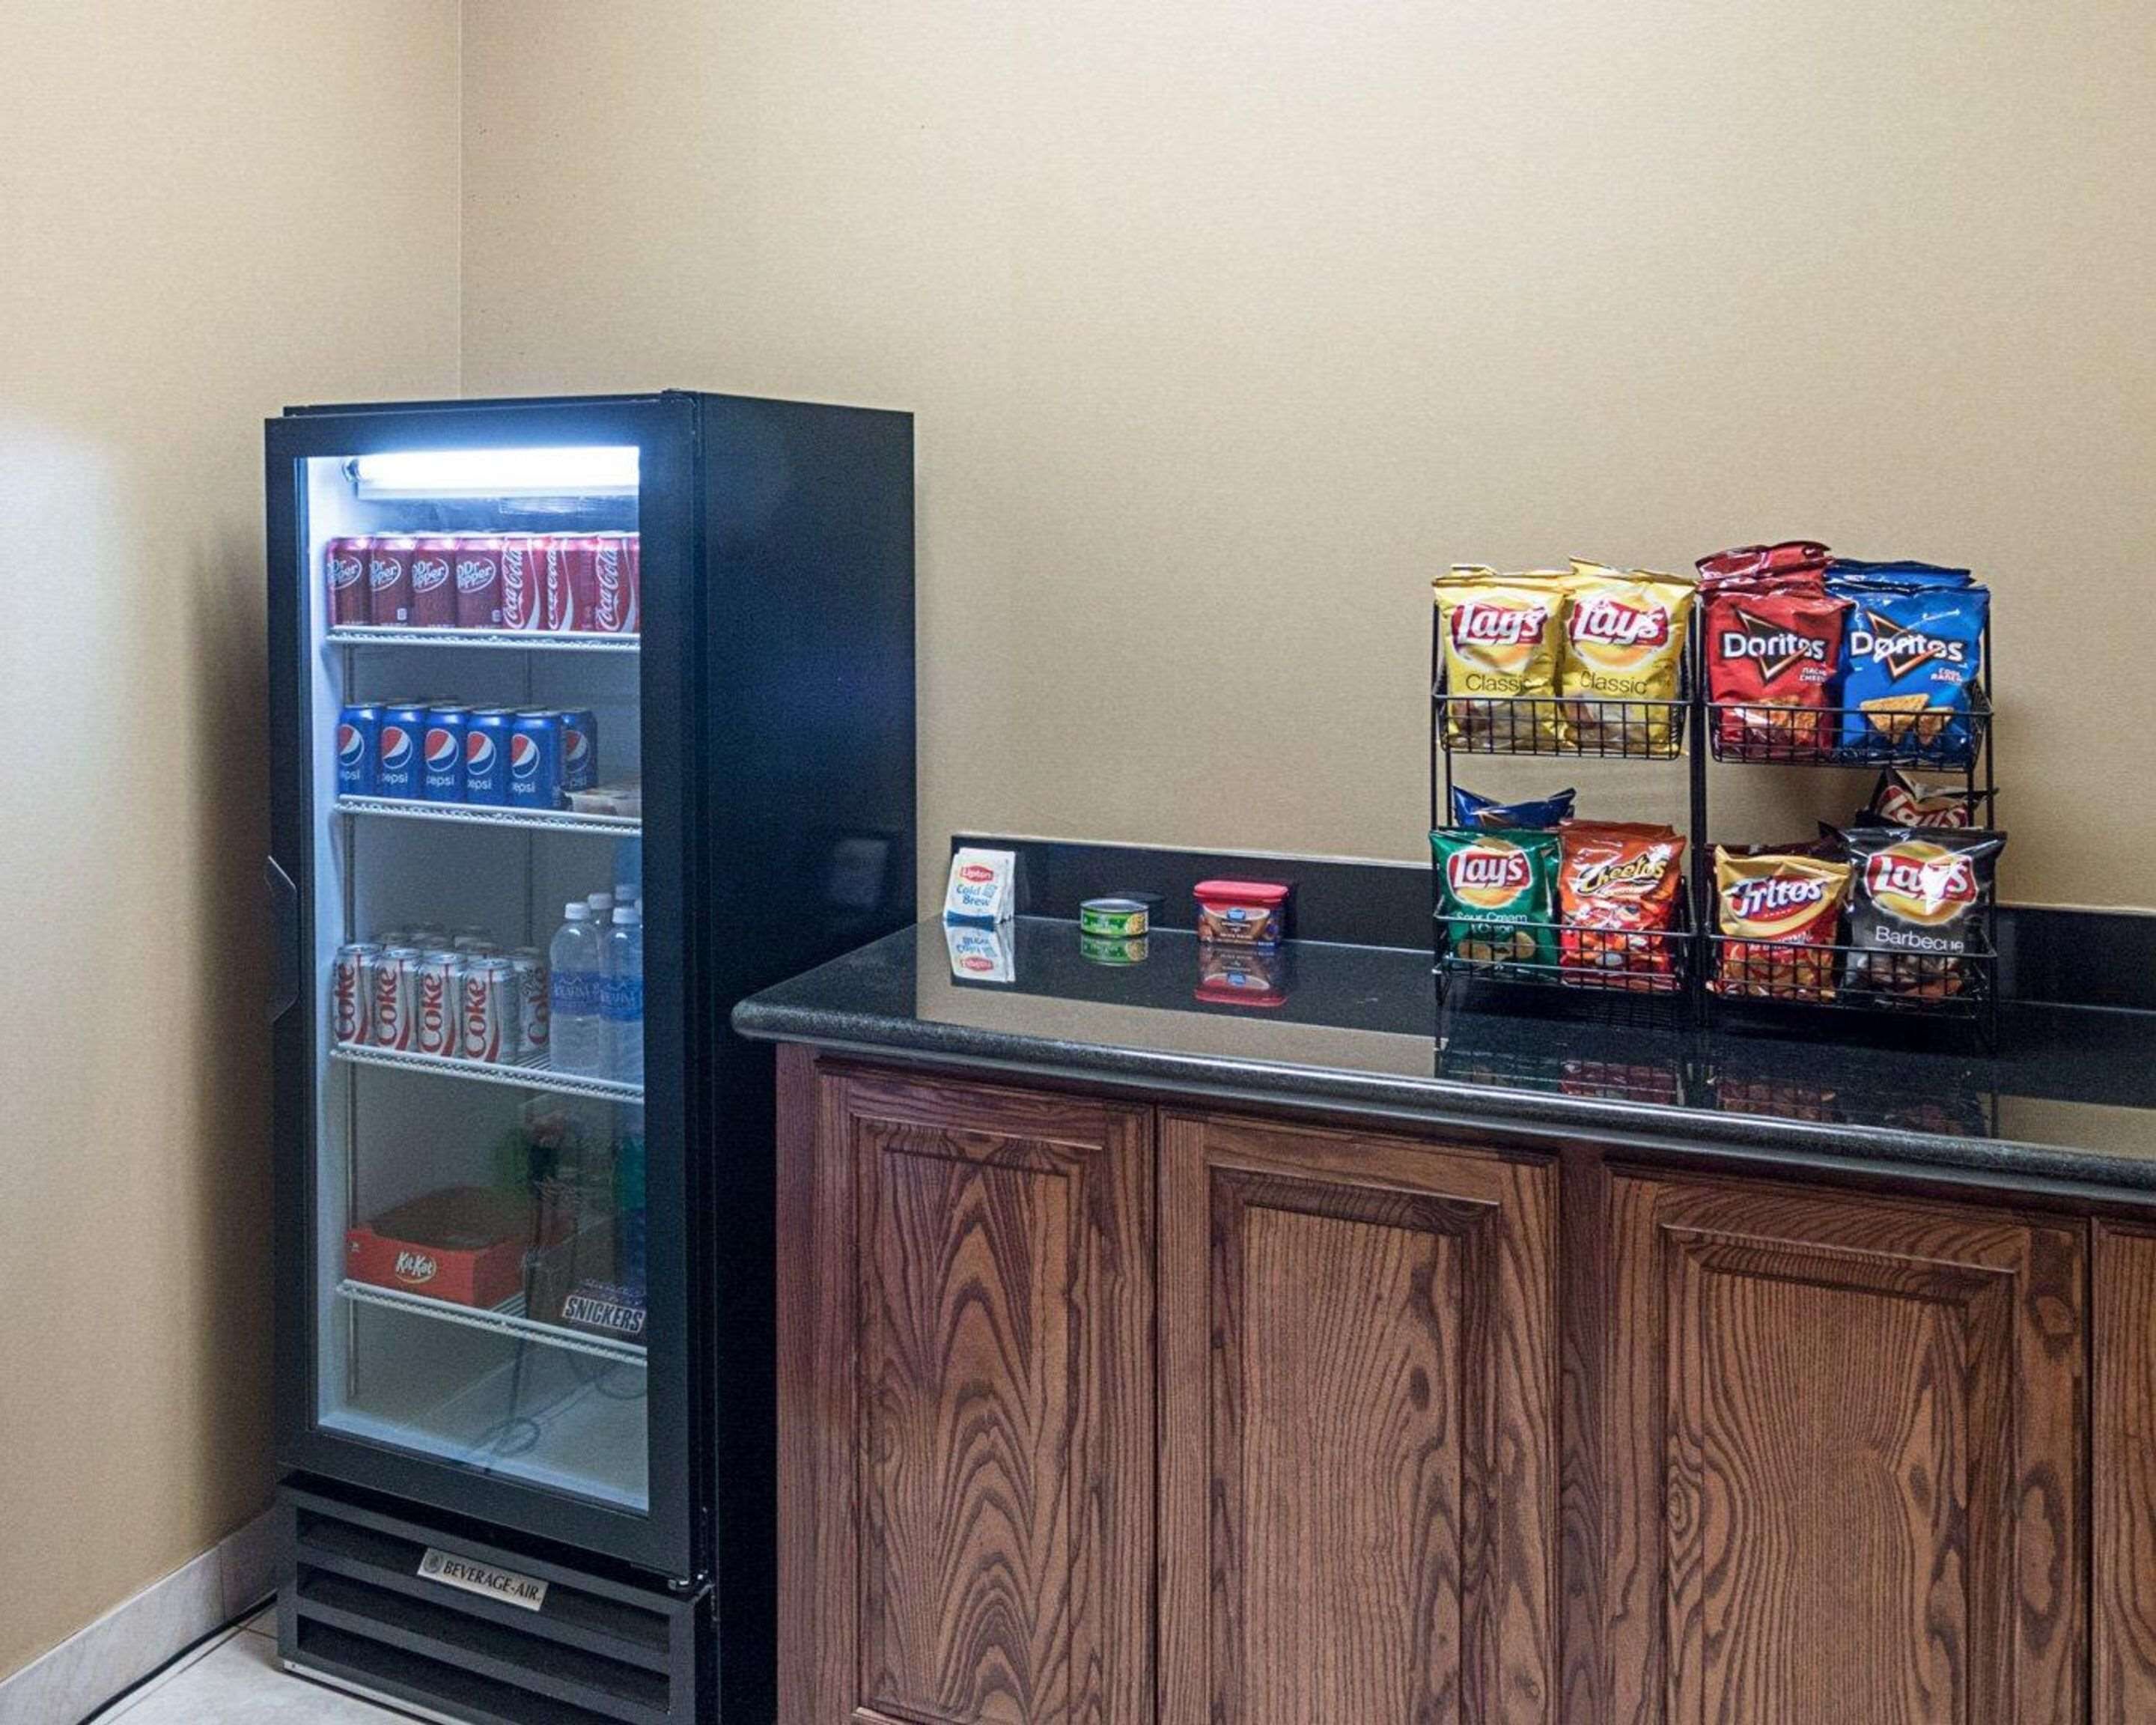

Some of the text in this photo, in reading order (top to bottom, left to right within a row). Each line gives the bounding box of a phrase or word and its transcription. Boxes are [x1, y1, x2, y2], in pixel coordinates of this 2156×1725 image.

[463, 561, 480, 574] Dr
[1723, 633, 1826, 659] Doritos
[1851, 631, 1964, 663] Doritos
[1465, 673, 1532, 692] Classic
[1580, 670, 1648, 695] Classic
[1453, 853, 1523, 889] Lay's
[1576, 852, 1669, 894] Cheetos
[962, 894, 990, 906] Brew
[1723, 876, 1827, 917] Fritos
[1875, 925, 1964, 953] Barbecue
[335, 963, 355, 1042] Coke
[377, 966, 398, 1046] Coke
[420, 973, 442, 1053] Coke
[464, 977, 486, 1059] Coke
[564, 1297, 643, 1332] SNICKERS
[443, 1560, 540, 1601] BEVERAGE-AIR
